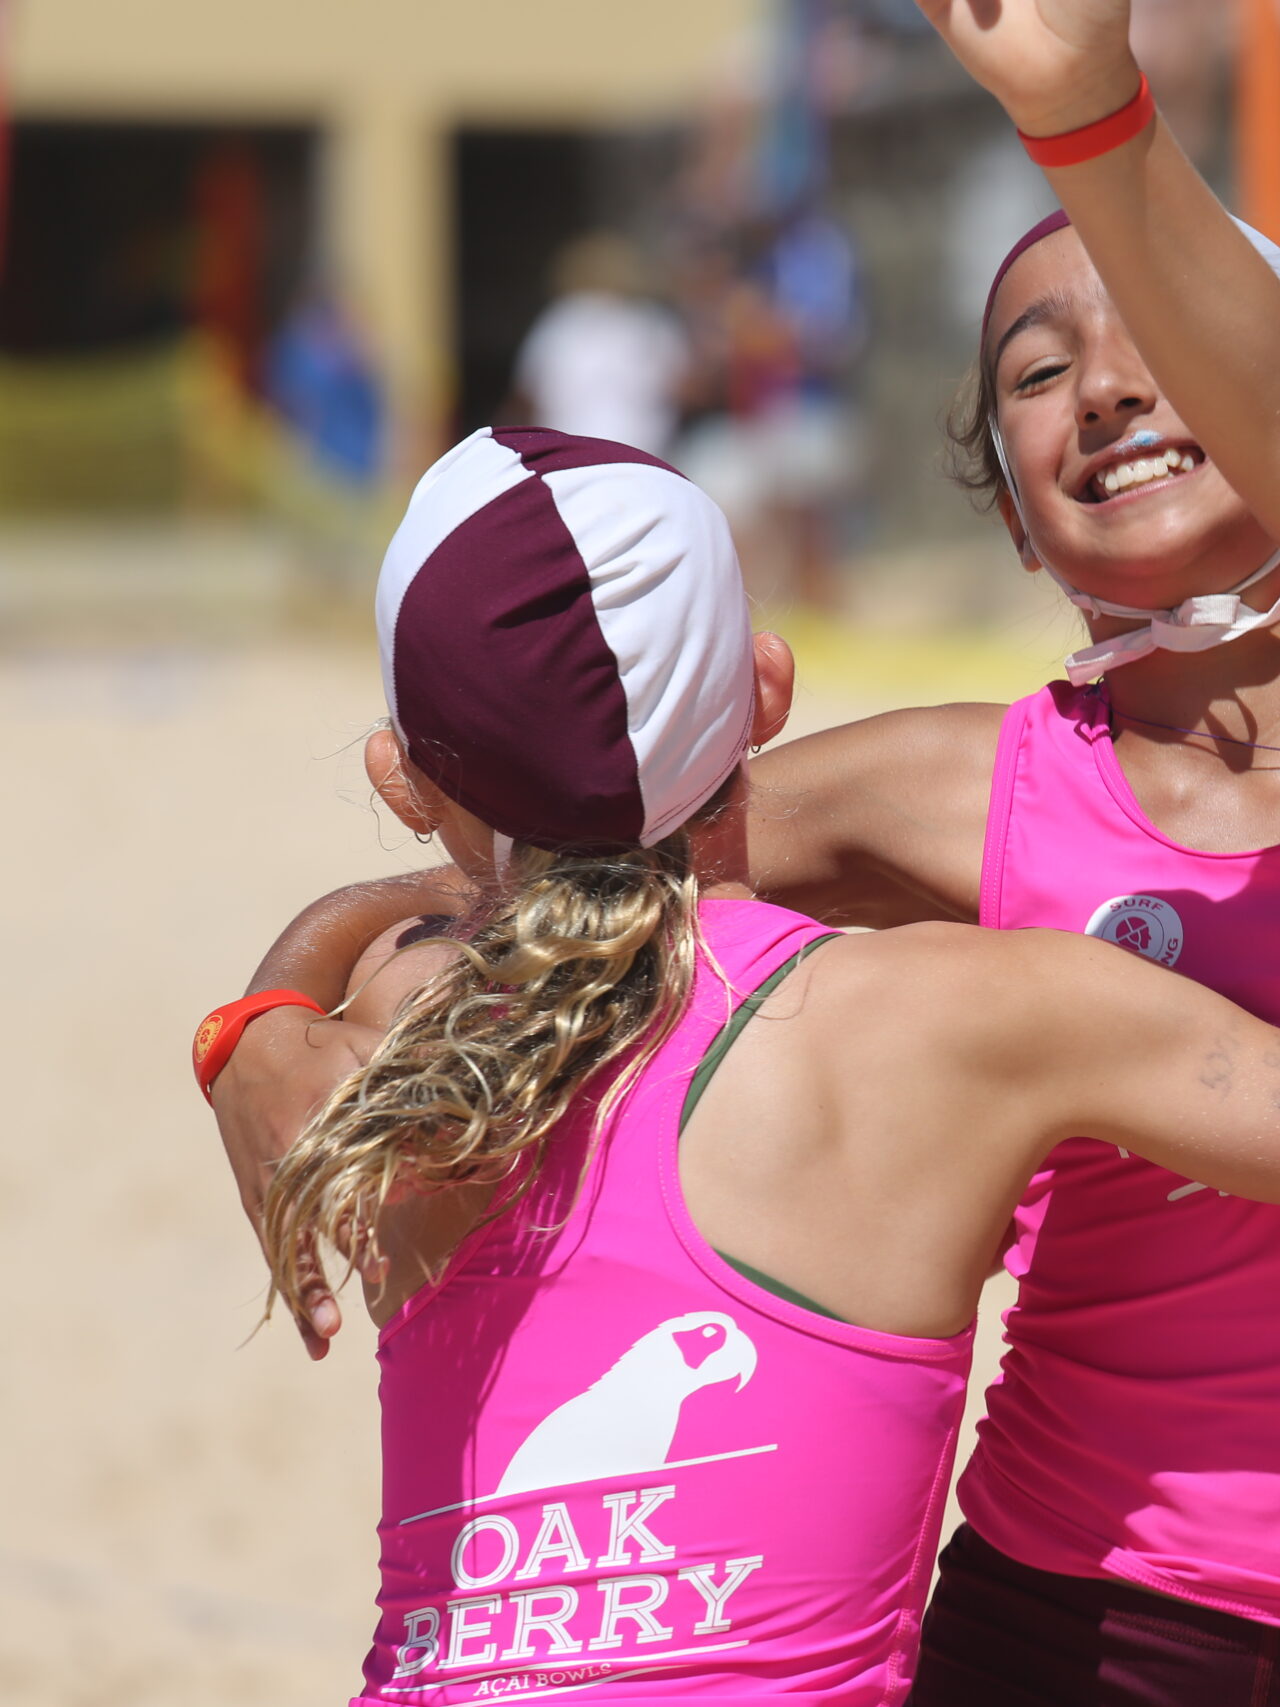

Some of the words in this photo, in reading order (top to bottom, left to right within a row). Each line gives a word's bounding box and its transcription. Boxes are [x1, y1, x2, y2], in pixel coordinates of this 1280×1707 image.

[1109, 898, 1164, 912] SURF
[450, 1485, 676, 1590] OAK
[392, 1555, 764, 1679] BERRY
[535, 1663, 612, 1687] BOWLS
